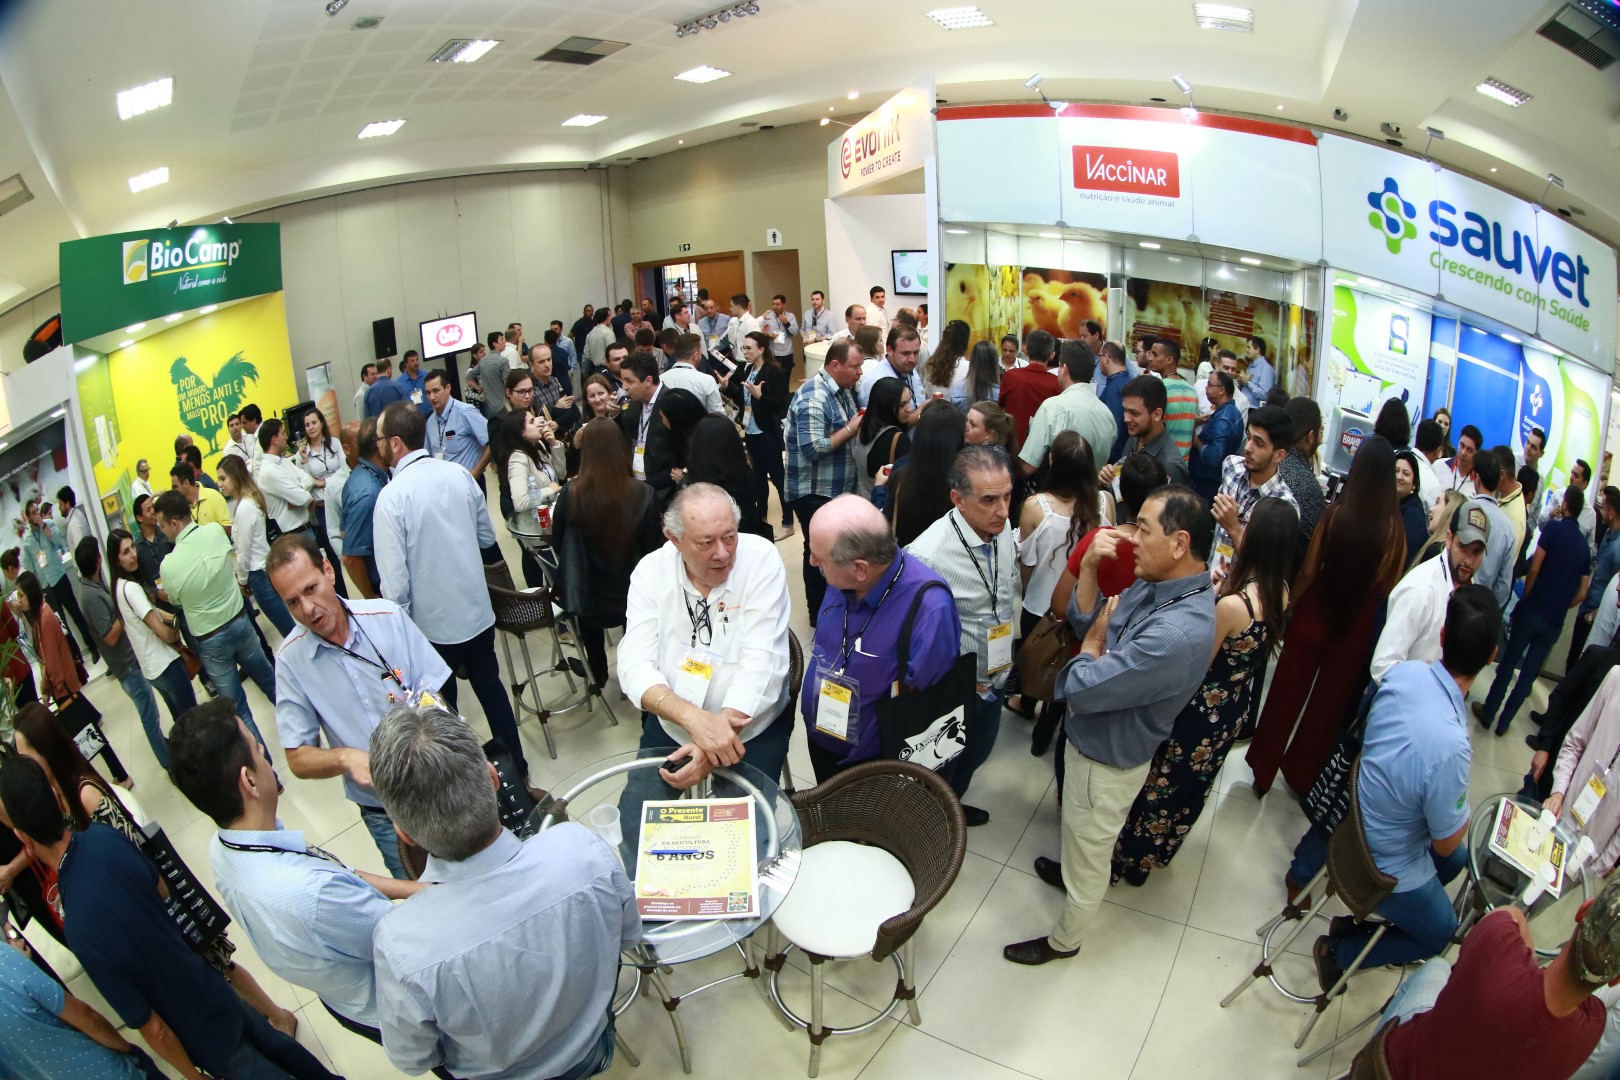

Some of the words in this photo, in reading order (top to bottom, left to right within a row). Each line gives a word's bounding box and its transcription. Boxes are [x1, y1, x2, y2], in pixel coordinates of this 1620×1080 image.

[860, 163, 874, 178] POWER
[876, 160, 882, 170] TO
[882, 150, 900, 168] CREATE
[1080, 192, 1113, 202] nutrição
[1122, 196, 1146, 205] saúde
[1147, 199, 1175, 208] animal
[1428, 200, 1590, 308] sauvet
[174, 272, 199, 295] Natural
[1430, 251, 1513, 296] Crescendo
[1516, 287, 1546, 311] com
[1549, 299, 1590, 332] Saúde
[180, 376, 196, 392] POR
[188, 385, 206, 396] MUNDO
[182, 390, 210, 412] MENOS
[214, 383, 232, 400] ANTI
[234, 380, 240, 392] E
[186, 410, 200, 420] MAIS
[668, 850, 714, 861] ANOS
